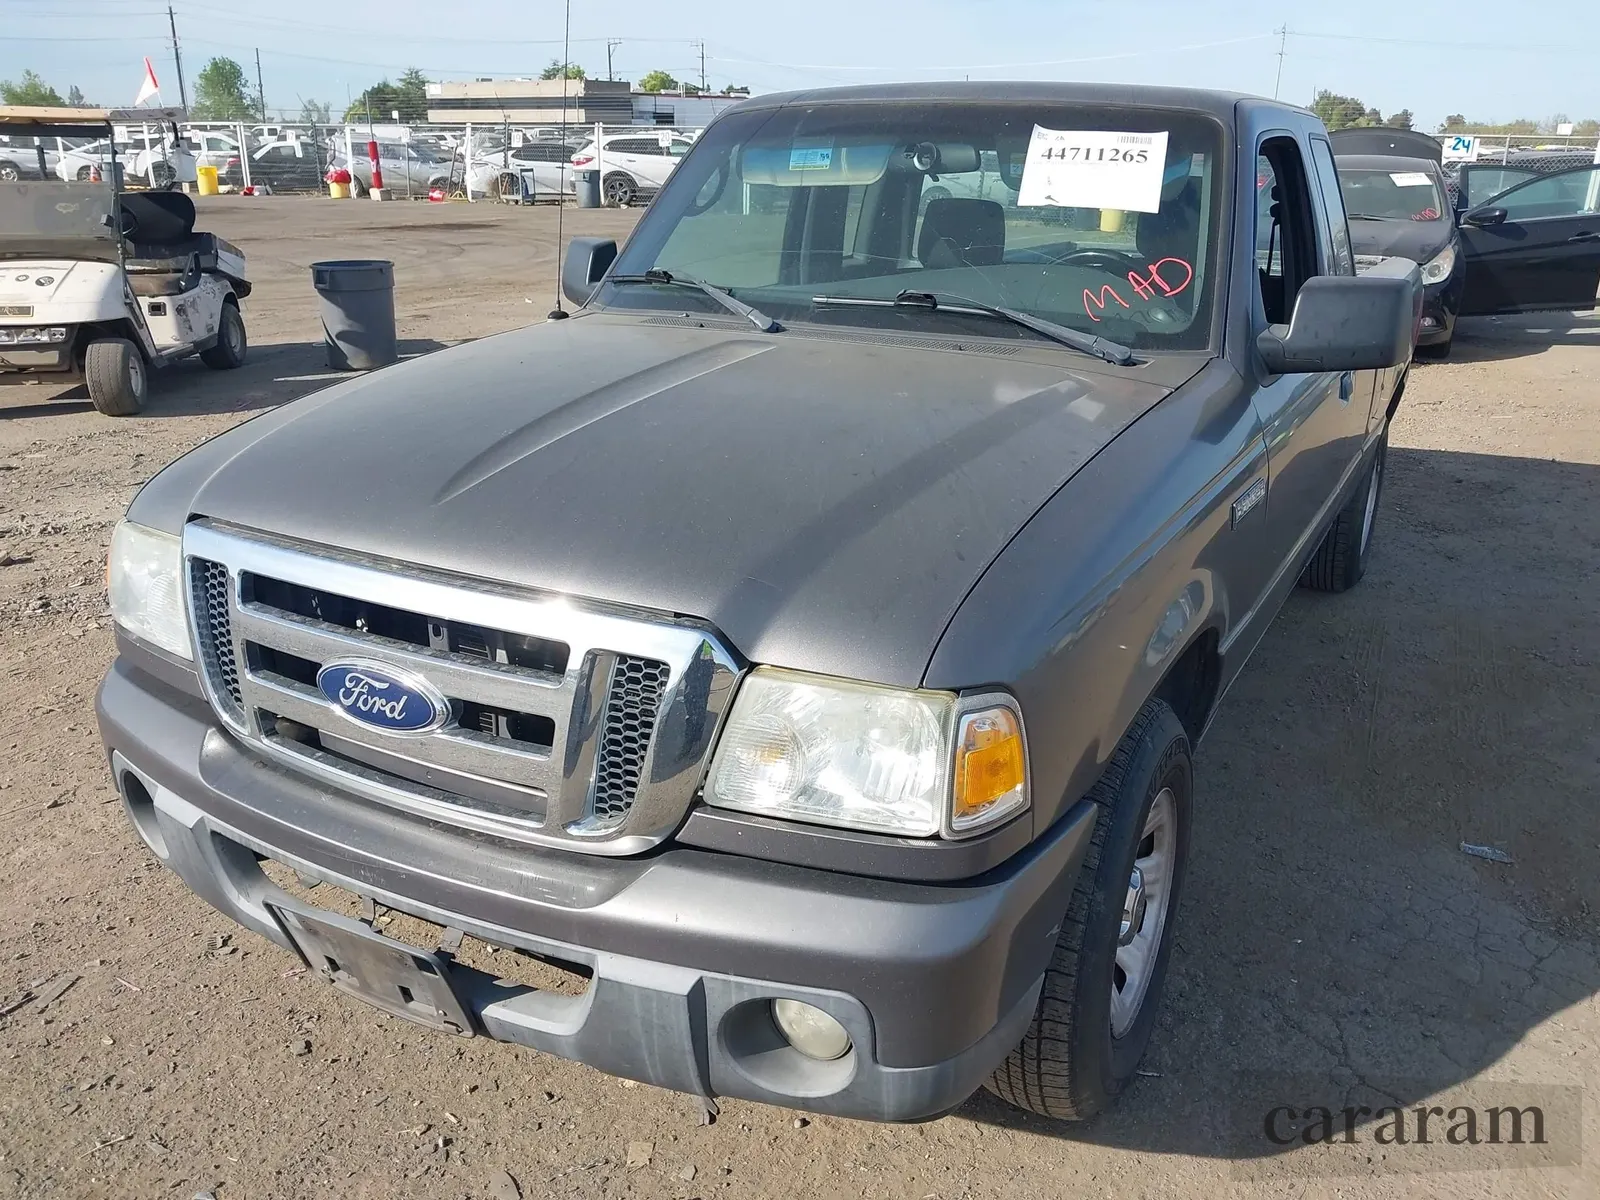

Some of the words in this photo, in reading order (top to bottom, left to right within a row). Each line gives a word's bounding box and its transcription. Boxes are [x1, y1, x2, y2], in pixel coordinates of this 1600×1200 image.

[512, 133, 521, 143] 19
[661, 131, 670, 142] 20
[1452, 136, 1471, 153] 24
[1041, 147, 1148, 164] 44711265
[1083, 257, 1193, 322] MAD
[339, 672, 408, 720] Ford
